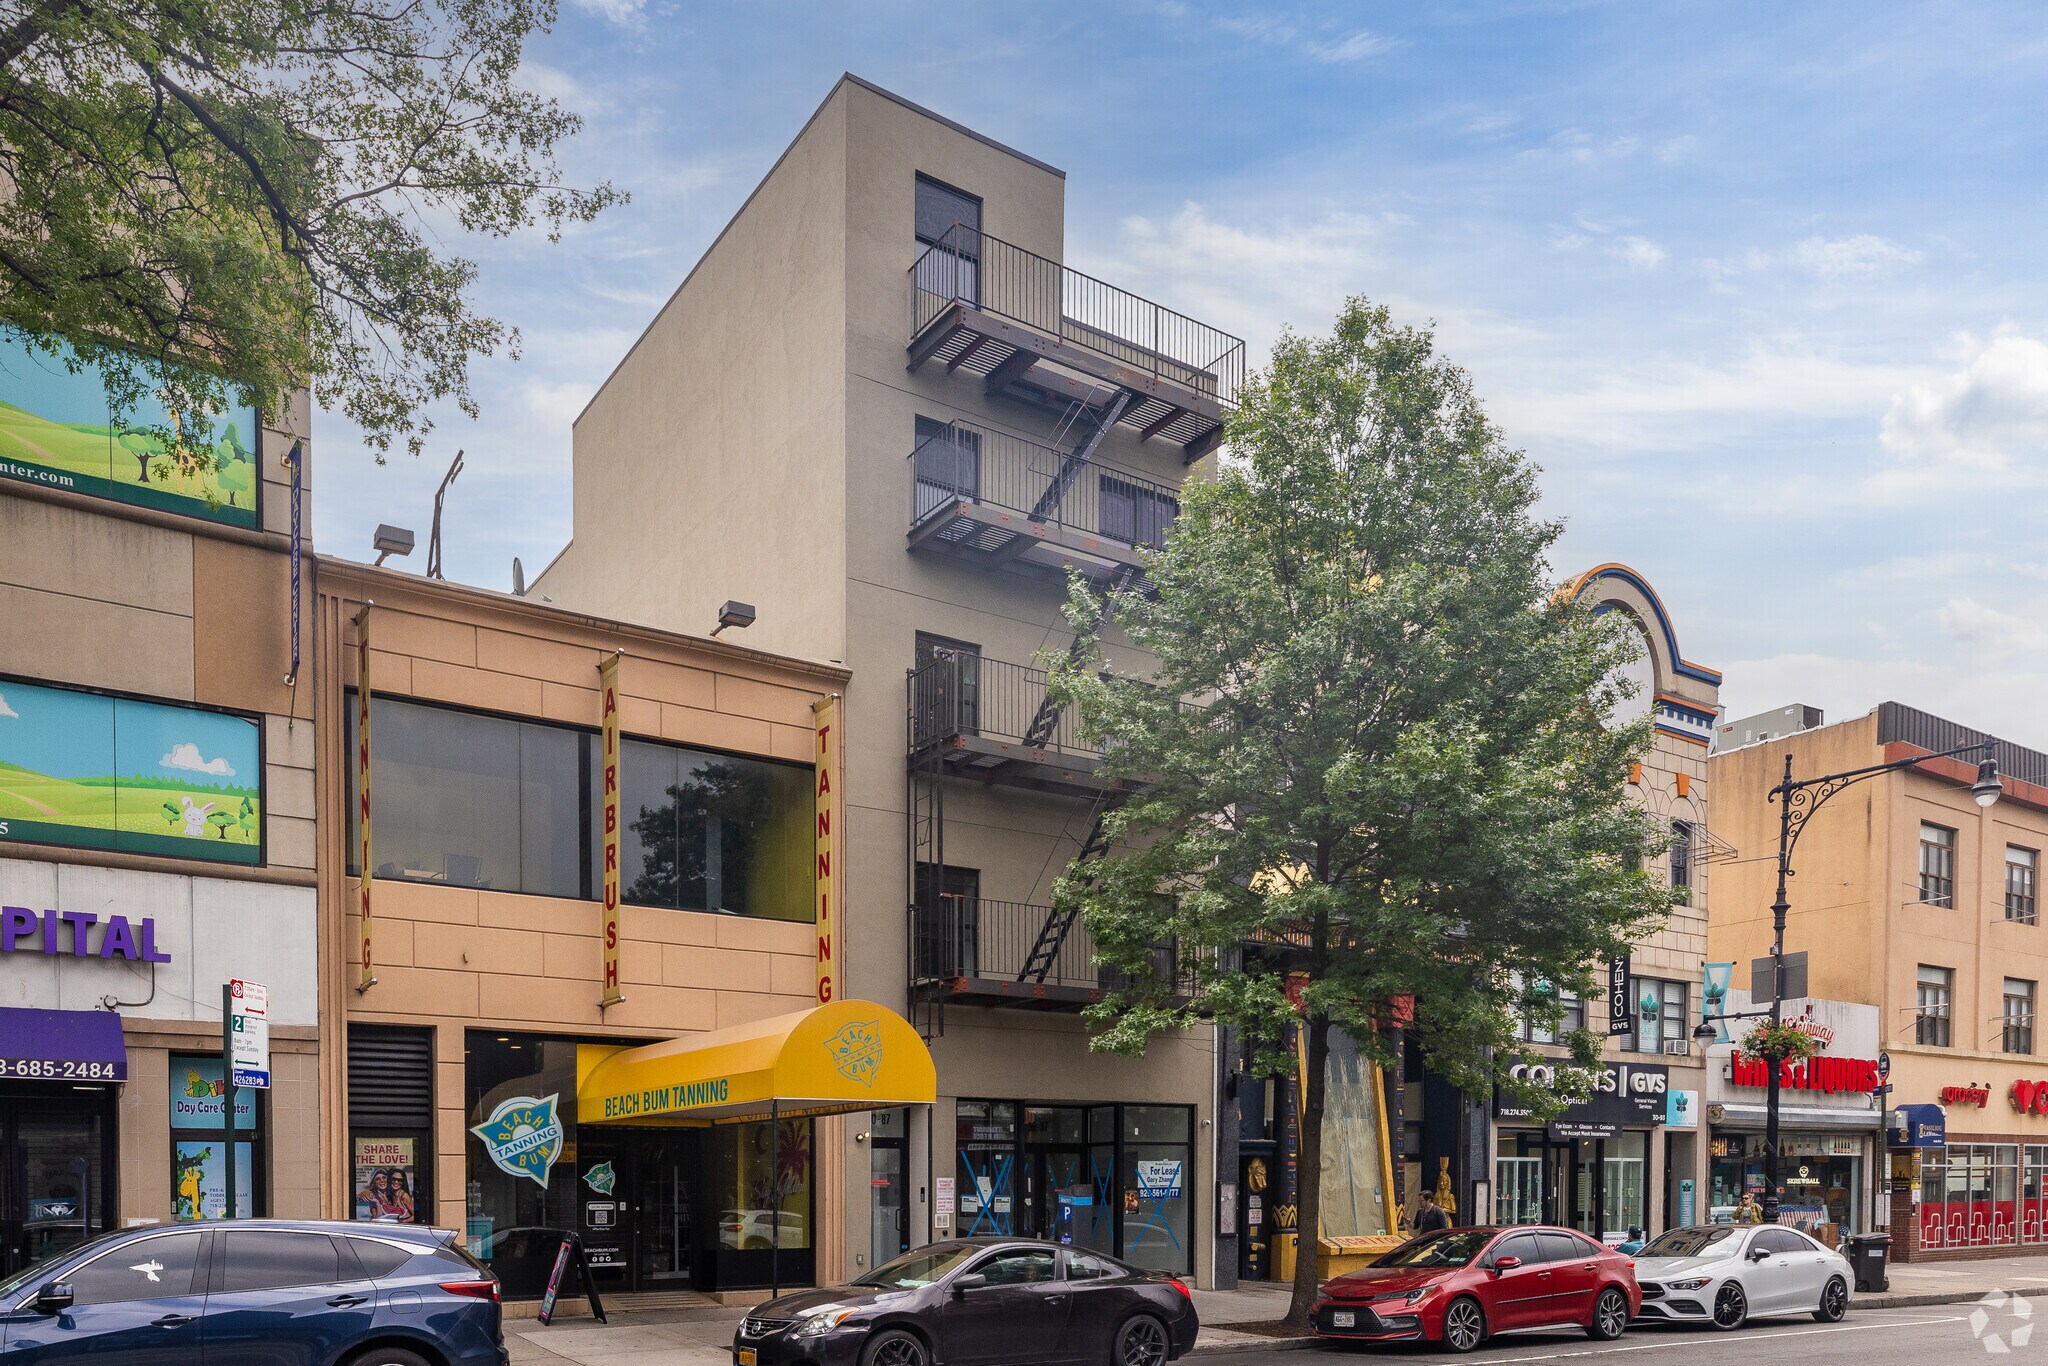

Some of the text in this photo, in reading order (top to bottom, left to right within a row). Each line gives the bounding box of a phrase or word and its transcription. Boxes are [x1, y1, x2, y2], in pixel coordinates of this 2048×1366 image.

[291, 580, 300, 662] CENTER
[360, 638, 371, 970] TANNING
[604, 687, 616, 990] AIRBRUSH
[818, 724, 832, 1004] TANNING
[2, 906, 172, 963] PITAL
[235, 1016, 241, 1031] 2
[1612, 1021, 1629, 1030] GVS
[839, 1029, 872, 1053] BEACH
[853, 1056, 875, 1074] BUM
[1807, 1056, 1878, 1094] LIQUORS
[235, 1075, 256, 1086] 426283
[1630, 1072, 1666, 1094] GVS
[177, 1101, 195, 1115] Day
[198, 1102, 218, 1113] Care
[606, 1079, 729, 1117] BEACH BUM TANNING
[1942, 1087, 1990, 1108] grocery
[498, 1110, 544, 1141] BEACH
[364, 1145, 399, 1154] SHARE
[495, 1127, 558, 1158] TANNING
[355, 1155, 409, 1164] THE LOVE!
[519, 1145, 551, 1167] BUM
[1147, 1176, 1158, 1184] Gary
[1150, 1166, 1179, 1176] For Lease
[1064, 1206, 1071, 1220] P
